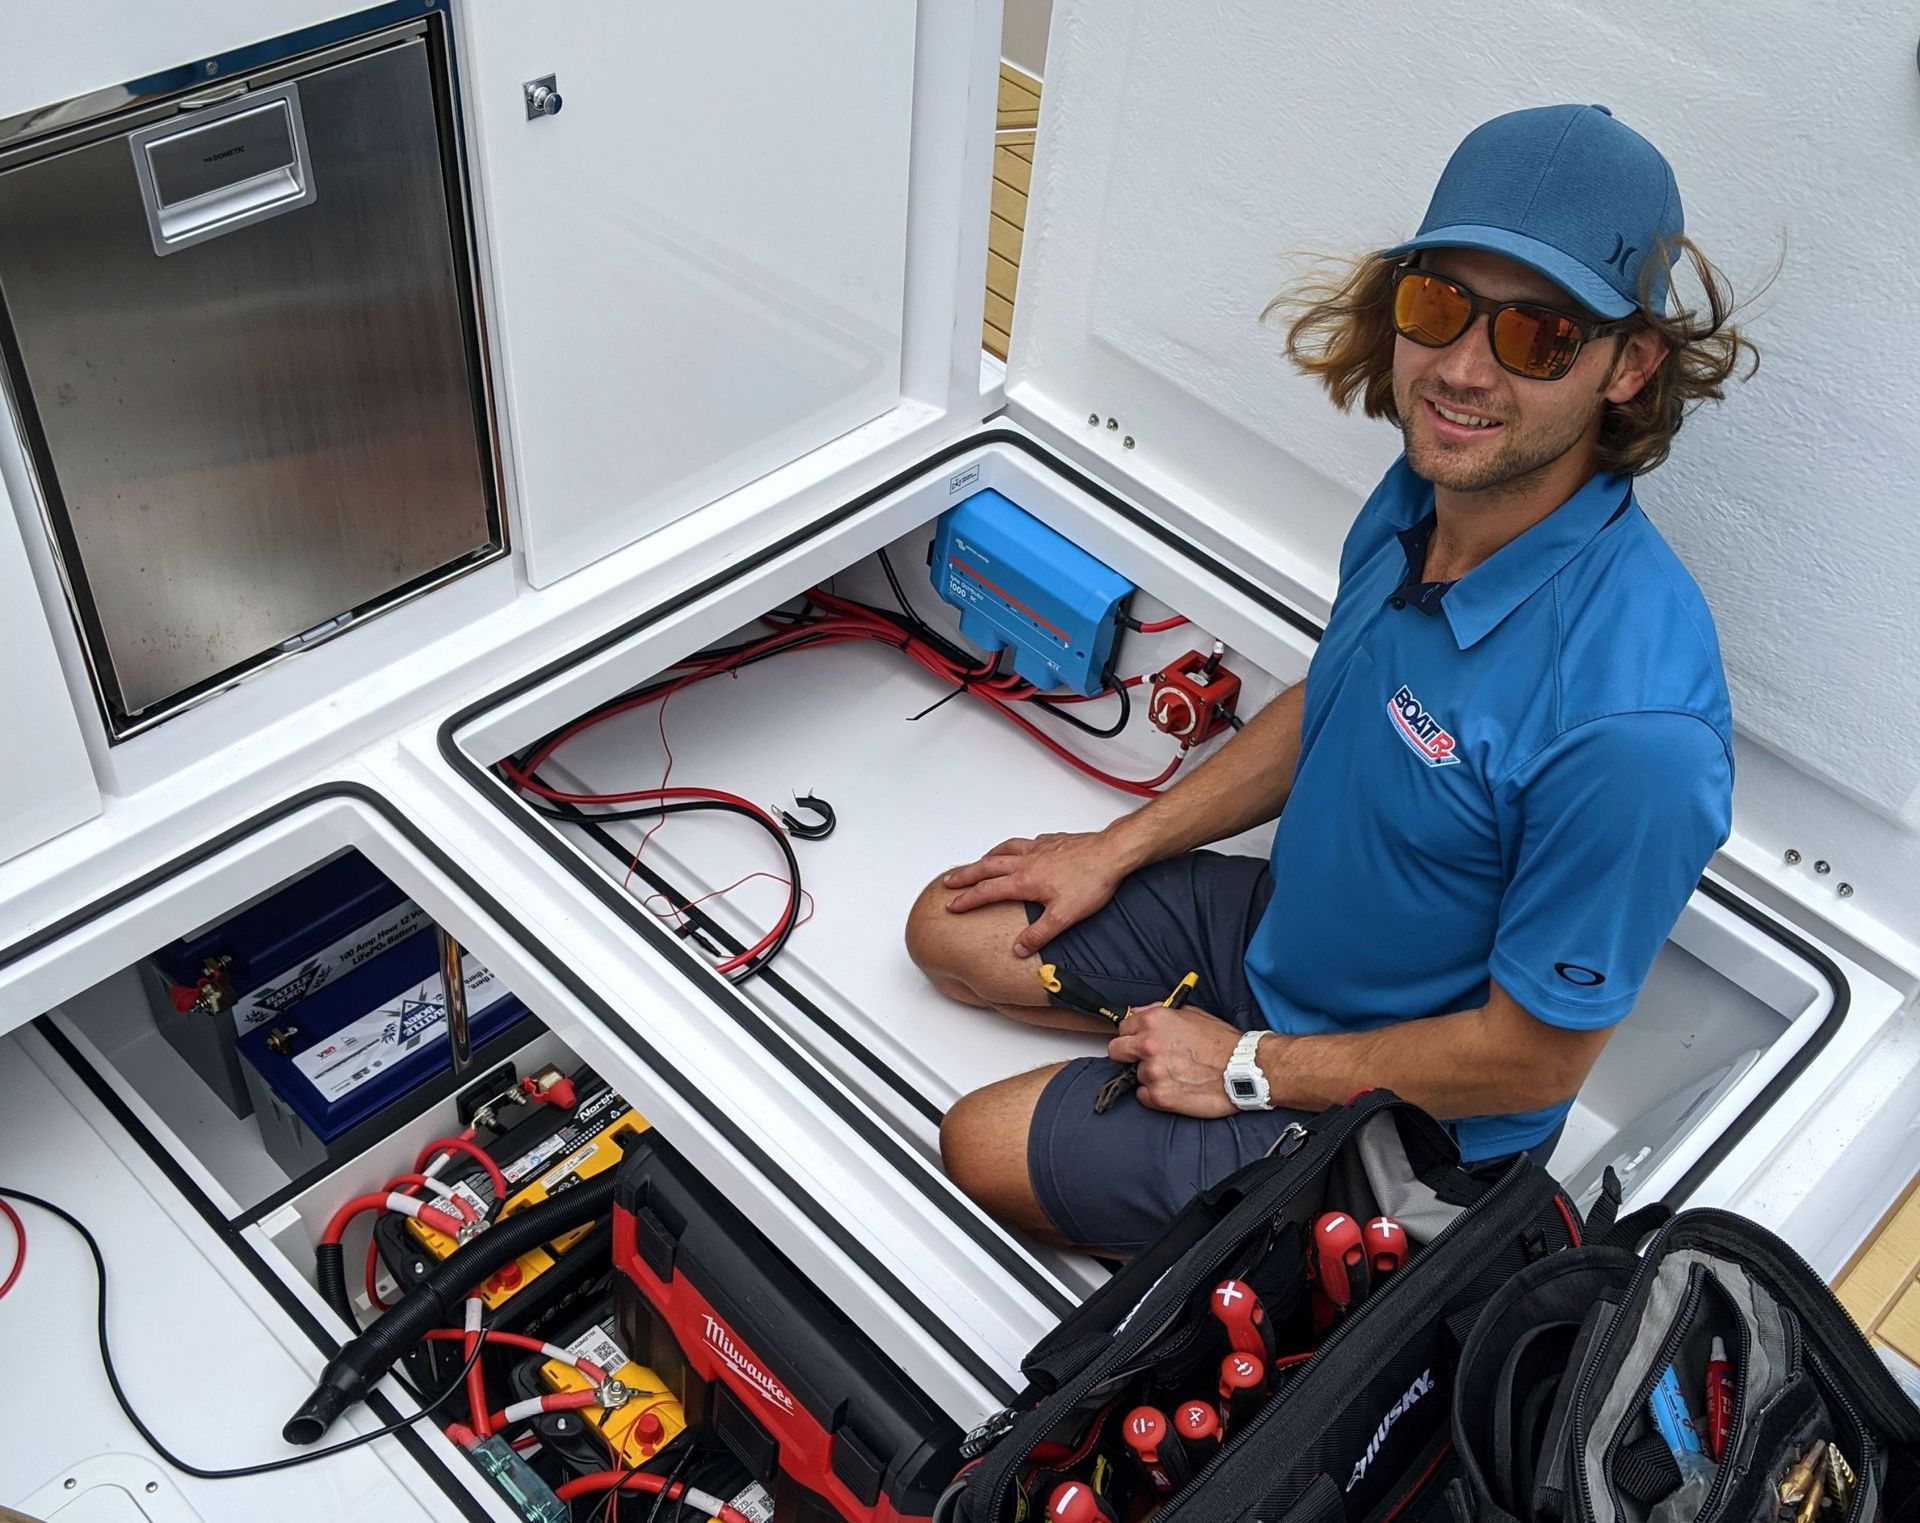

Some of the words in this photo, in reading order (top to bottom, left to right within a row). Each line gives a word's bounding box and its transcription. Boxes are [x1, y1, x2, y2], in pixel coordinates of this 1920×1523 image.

[949, 583, 967, 598] 1000
[339, 948, 355, 962] 100
[355, 937, 376, 953] Amp
[377, 924, 399, 940] Hour
[399, 915, 410, 926] 12
[386, 922, 418, 945] Battery
[264, 973, 311, 1006] BATTLE
[272, 983, 307, 1008] BORN
[402, 1006, 446, 1037] BATTLE
[403, 1004, 436, 1028] BORN
[701, 1313, 795, 1411] Milwaukee
[1366, 1367, 1430, 1465] HUSKY
